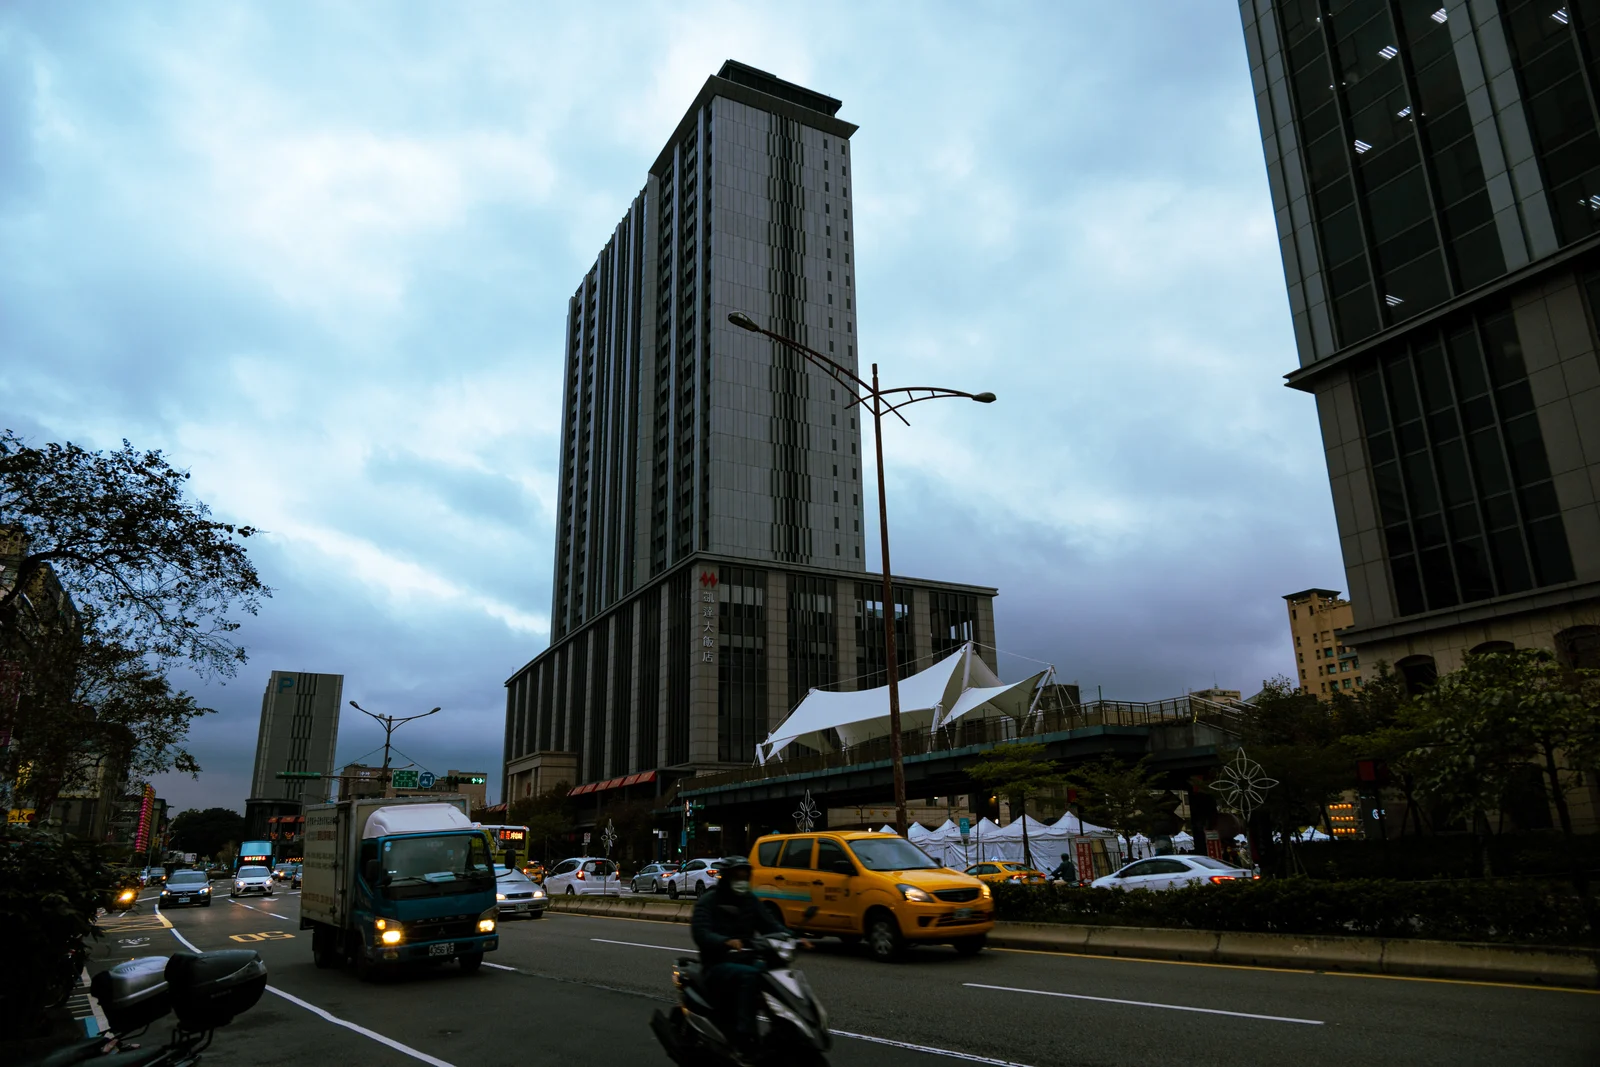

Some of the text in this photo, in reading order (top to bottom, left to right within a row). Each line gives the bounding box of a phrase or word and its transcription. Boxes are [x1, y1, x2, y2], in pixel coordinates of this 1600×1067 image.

[702, 592, 714, 662] 凱達大飯店
